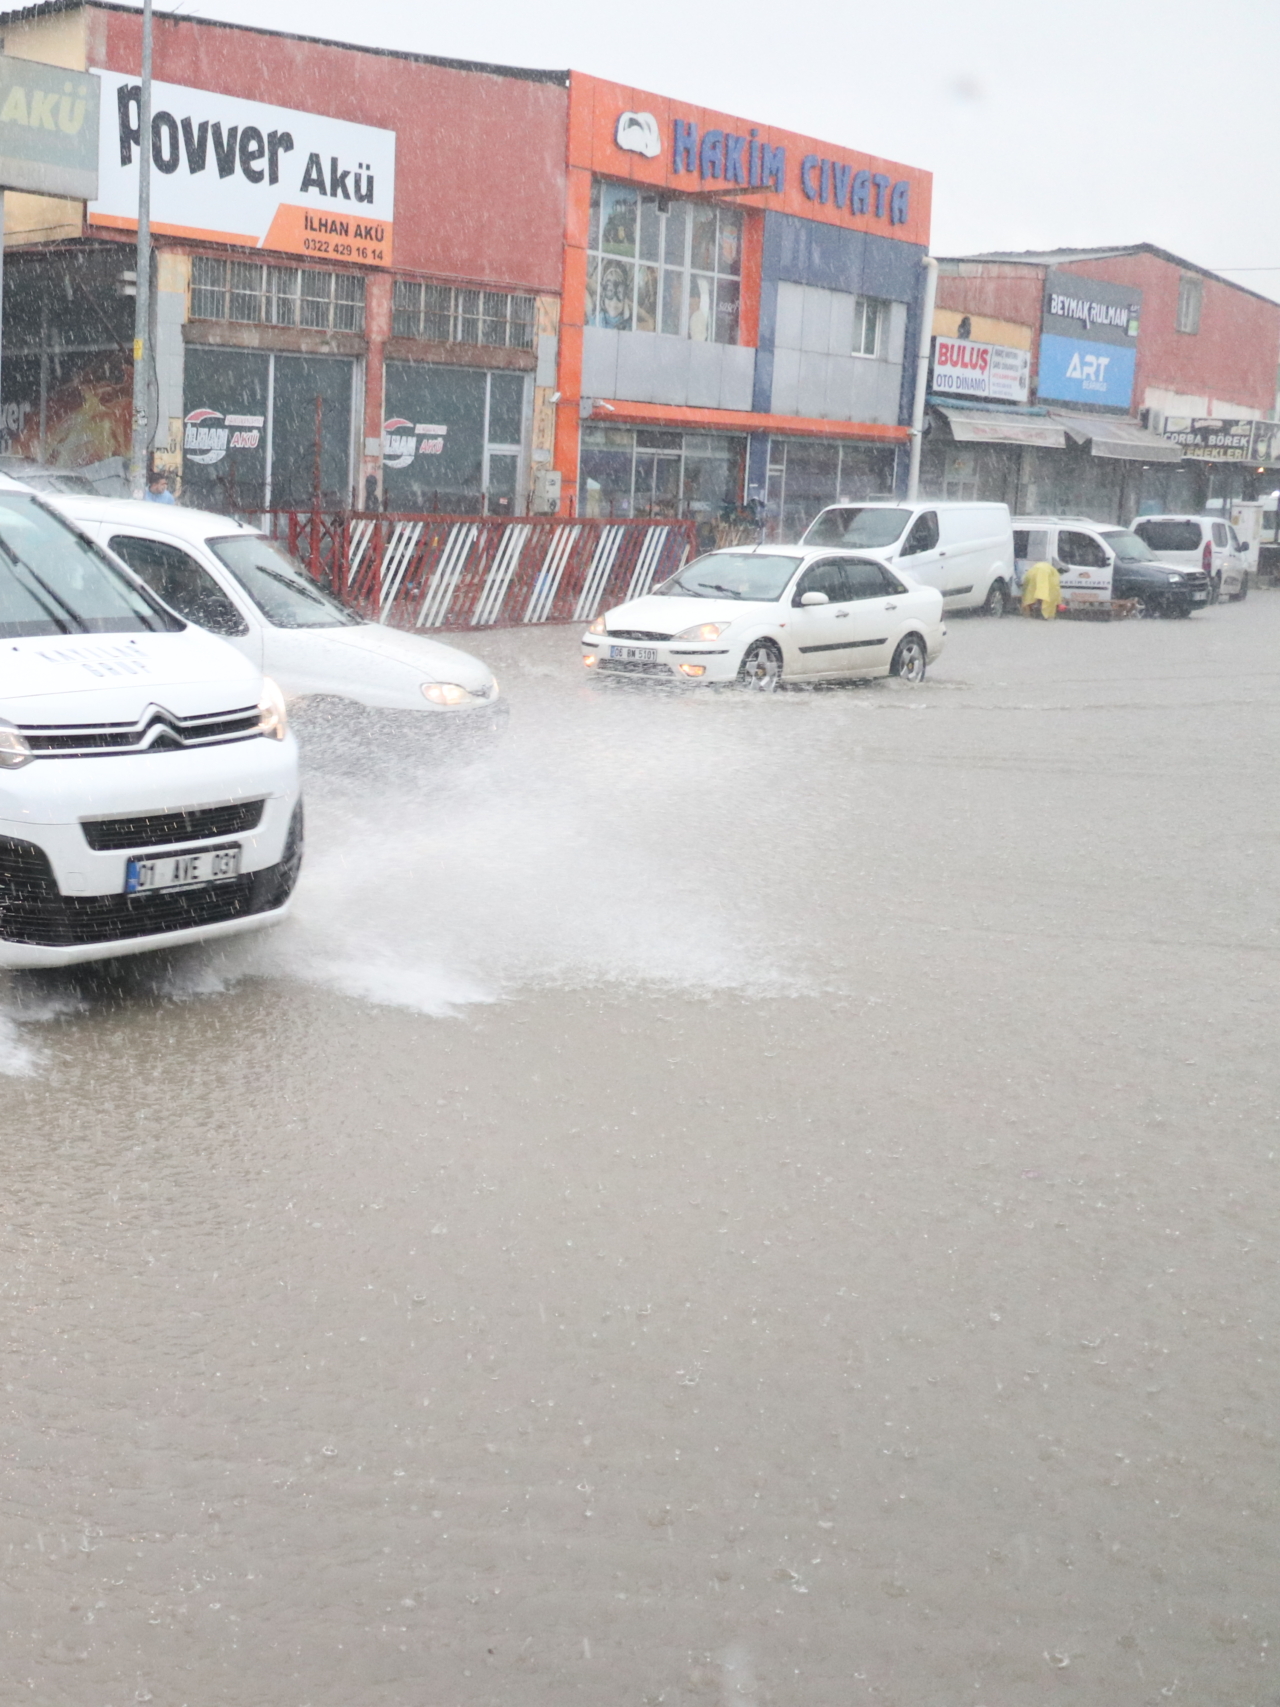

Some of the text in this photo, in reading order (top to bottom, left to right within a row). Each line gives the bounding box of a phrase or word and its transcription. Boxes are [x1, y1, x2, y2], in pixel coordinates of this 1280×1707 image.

[0, 82, 87, 134] AKÜ
[300, 152, 375, 204] Akü
[673, 119, 910, 225] HAKİM CIVATA
[304, 211, 384, 242] İLHAN AKÜ
[303, 238, 383, 261] 0322 429 16 14
[1051, 294, 1128, 329] BEYMAK RULMAN
[937, 342, 989, 375] BULUŞ
[1066, 352, 1110, 381] ART
[936, 373, 953, 388] OTO
[956, 373, 987, 392] DİNAMO
[230, 430, 260, 448] AKÜ
[1208, 432, 1249, 447] BÖREK
[139, 863, 155, 887] 01
